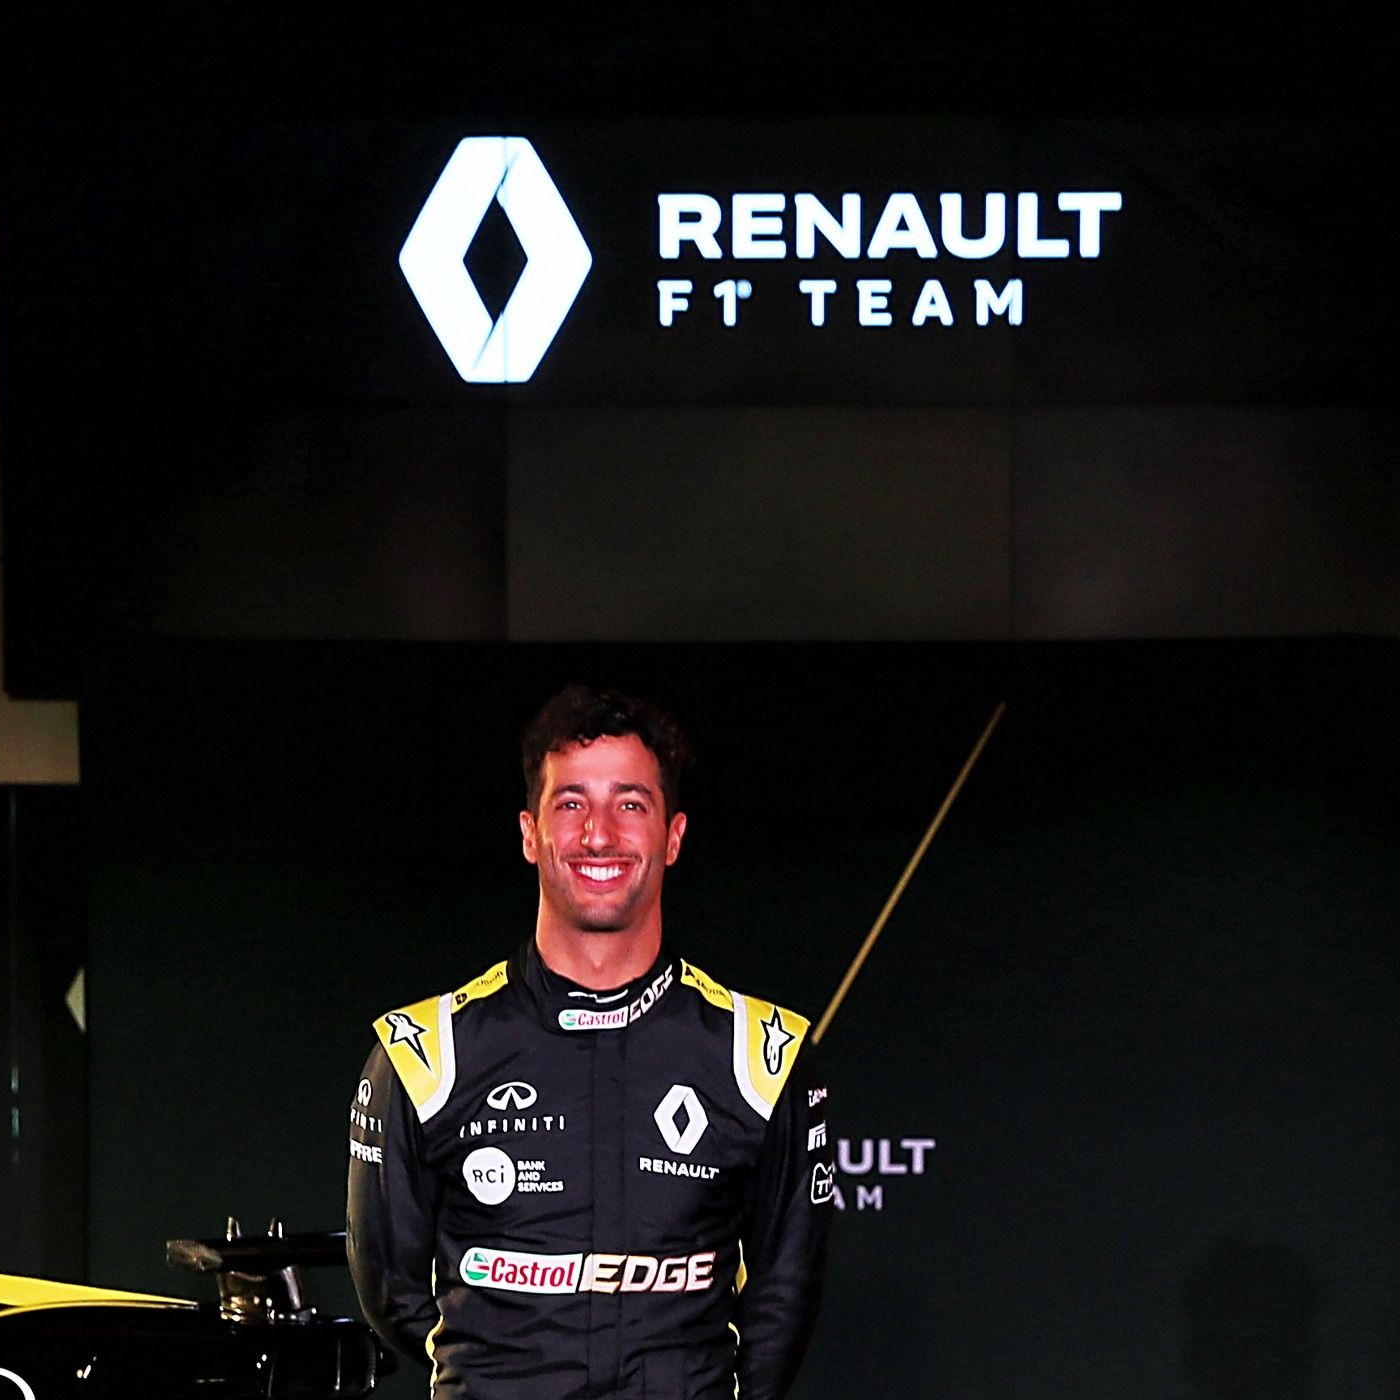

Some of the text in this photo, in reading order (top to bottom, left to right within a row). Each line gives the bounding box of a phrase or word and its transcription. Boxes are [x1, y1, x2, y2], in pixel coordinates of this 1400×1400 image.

[658, 192, 1123, 259] RENAULT
[800, 279, 1024, 327] TEAM
[577, 1010, 626, 1027] Castrol
[459, 1115, 565, 1139] INFINITI
[517, 1160, 546, 1171] BANK
[832, 1138, 936, 1175] ULT
[517, 1171, 541, 1182] AND
[639, 1157, 720, 1180] RENAULT
[517, 1181, 564, 1193] SERVICES
[491, 1251, 717, 1294] Castrol EDGE
